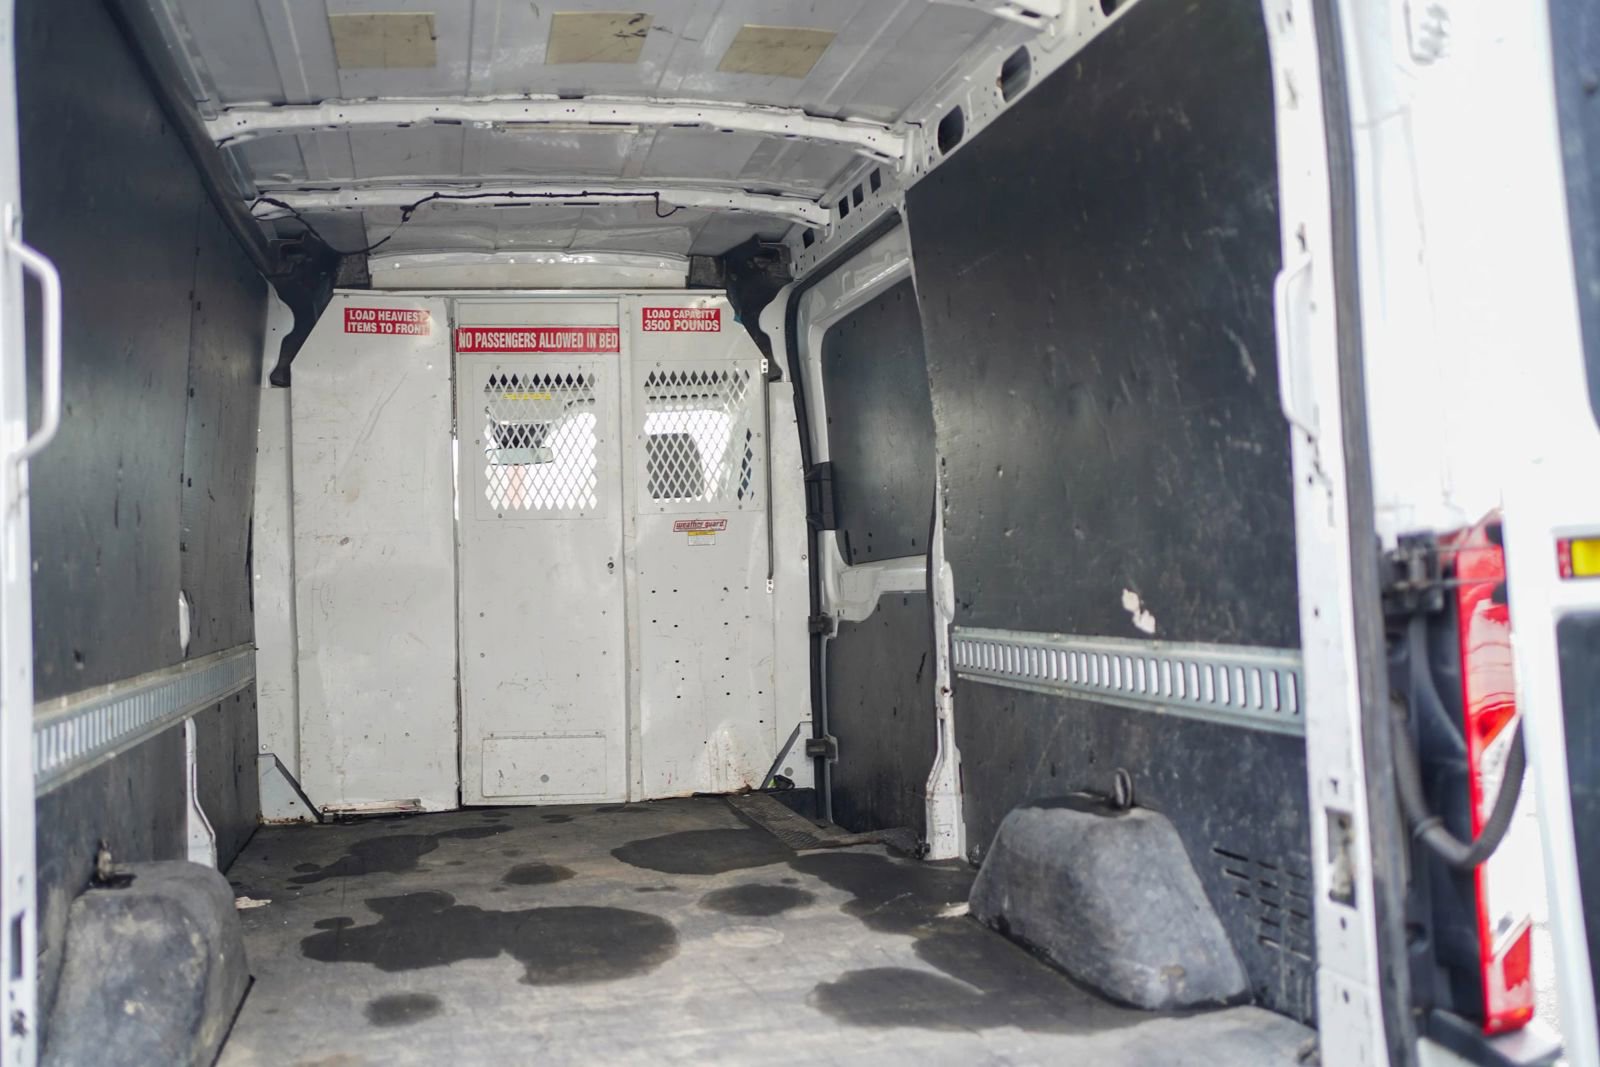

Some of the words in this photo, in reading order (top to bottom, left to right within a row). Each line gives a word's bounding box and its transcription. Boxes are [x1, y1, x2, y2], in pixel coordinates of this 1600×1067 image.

[349, 310, 376, 320] LOAD
[647, 310, 671, 319] LOAD
[672, 310, 716, 319] CAPACITY
[347, 322, 377, 332] ITEMS
[379, 323, 393, 333] TO
[644, 320, 671, 331] 3500
[673, 320, 719, 331] POUNDS
[458, 332, 472, 348] NO
[475, 332, 537, 348] PASSENGERS
[539, 332, 584, 348] ALLOWED
[586, 332, 597, 348] IN
[599, 332, 618, 348] BED
